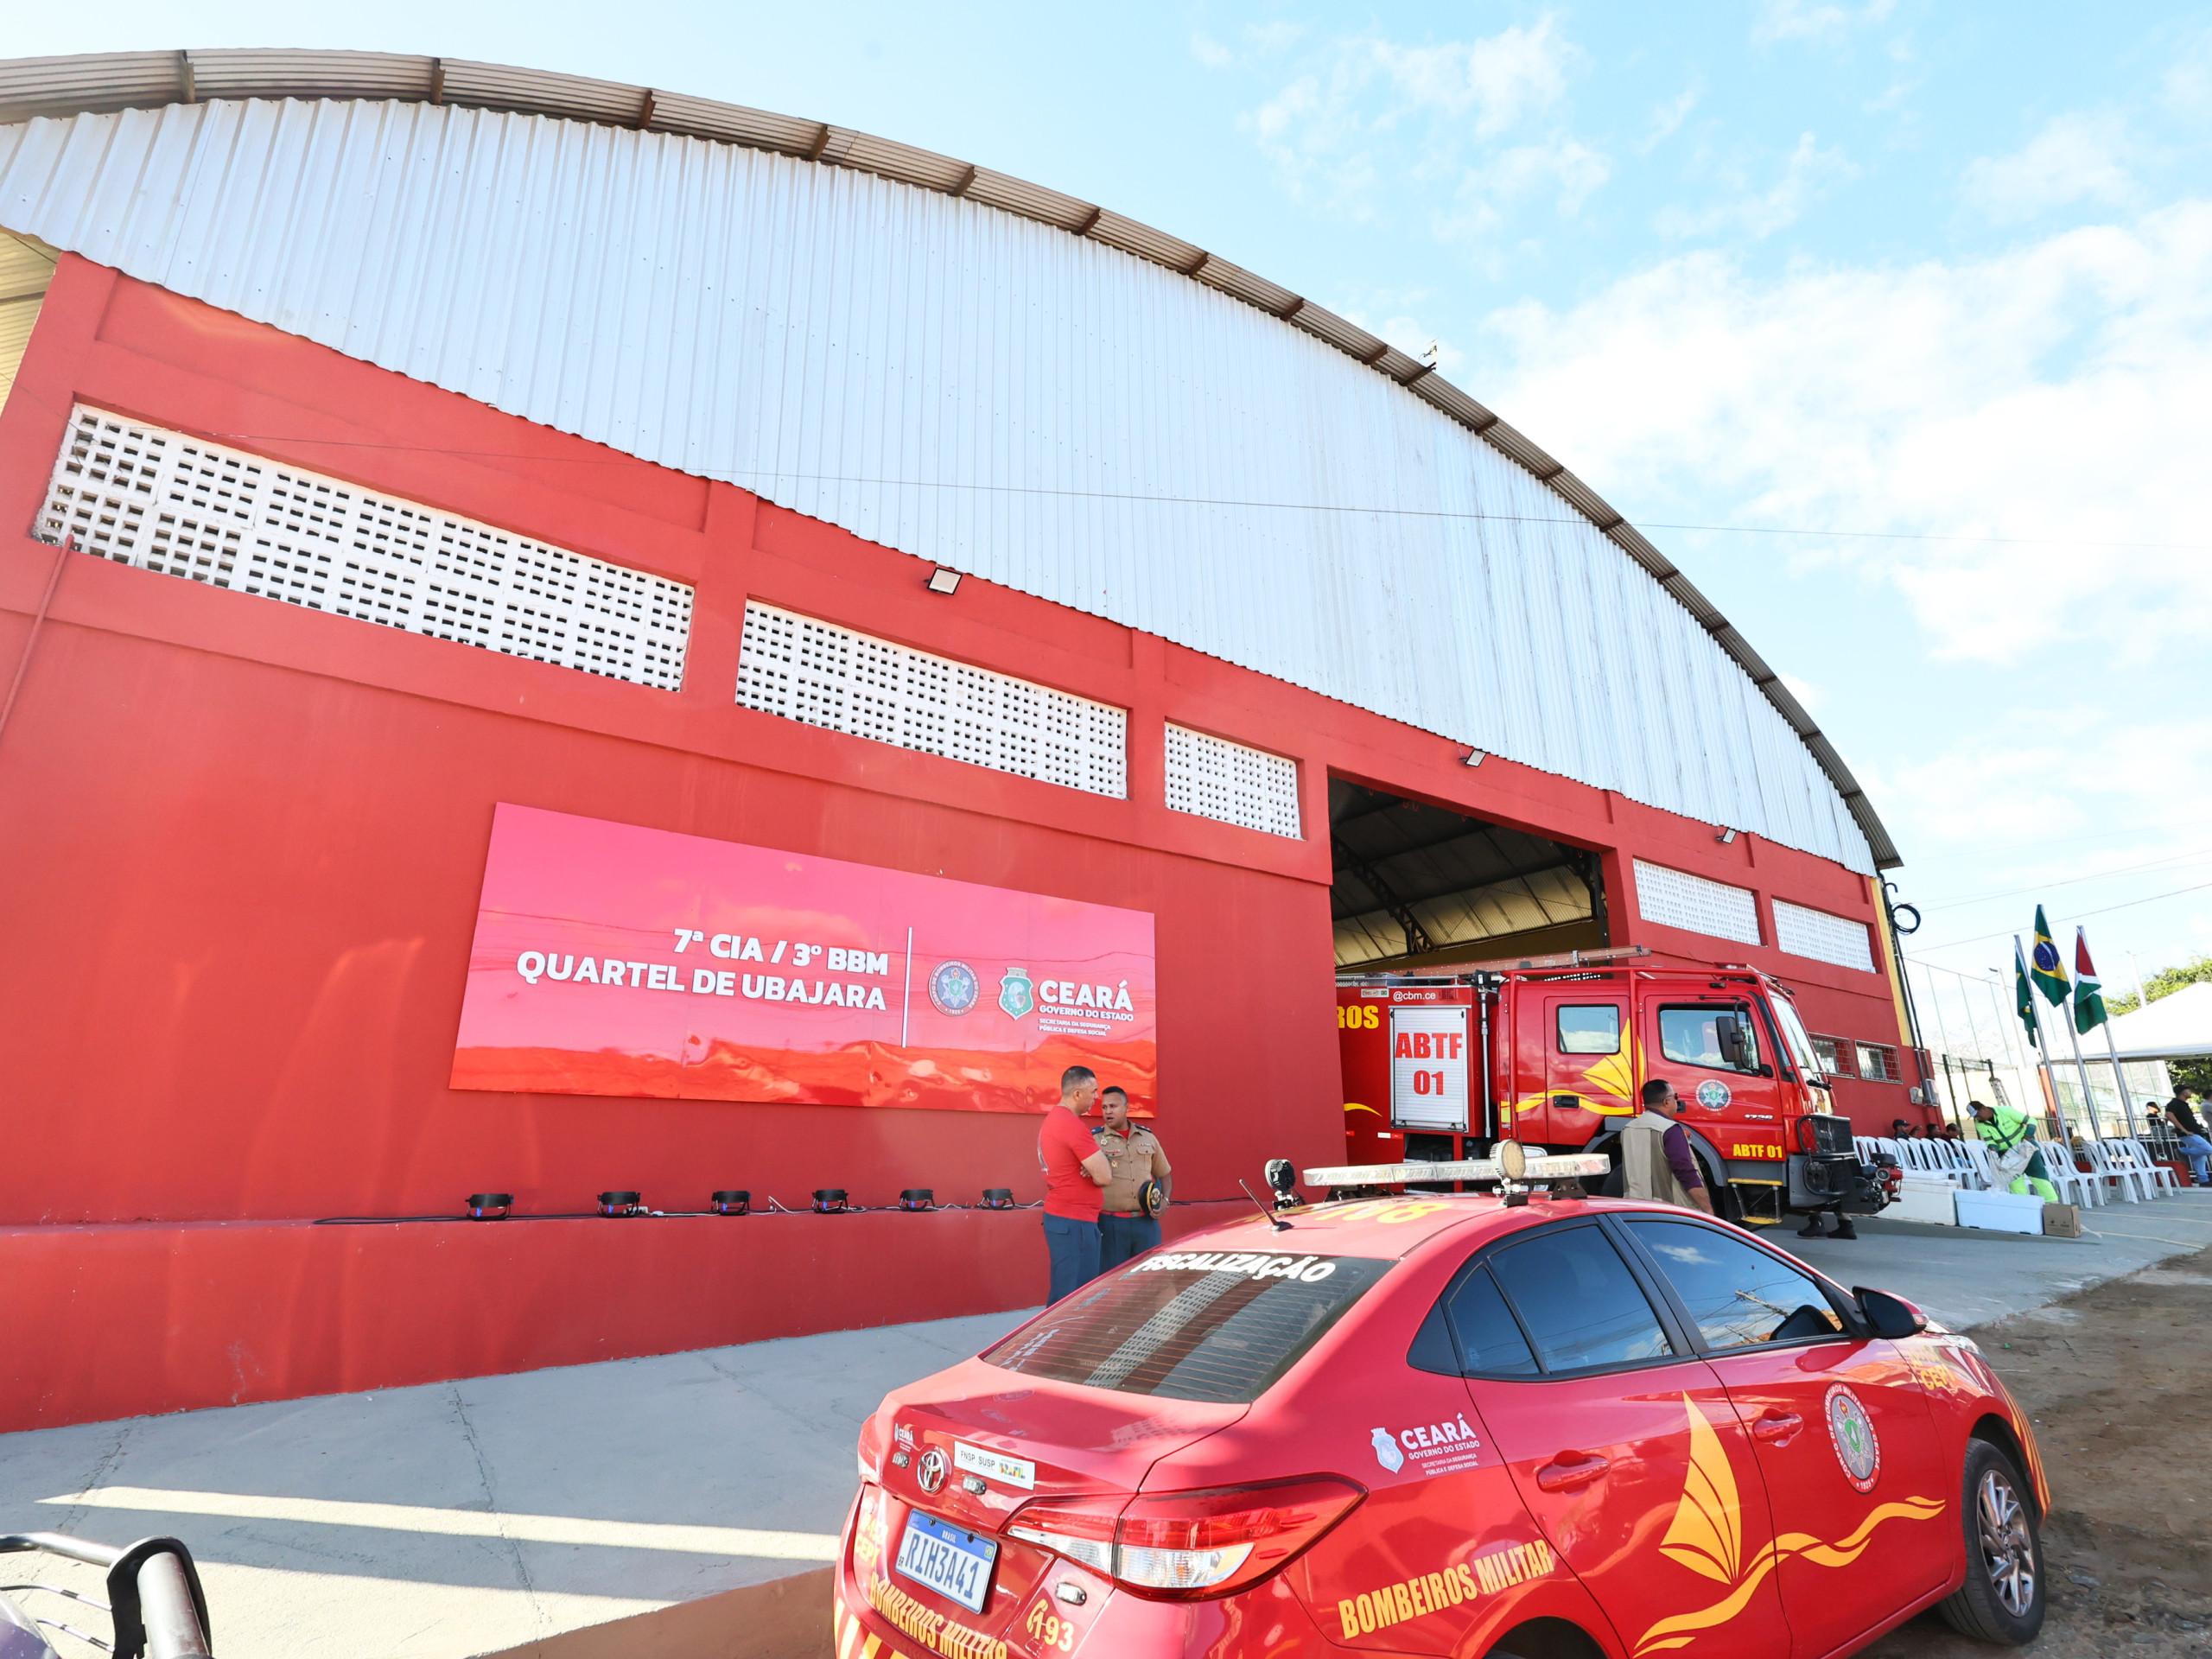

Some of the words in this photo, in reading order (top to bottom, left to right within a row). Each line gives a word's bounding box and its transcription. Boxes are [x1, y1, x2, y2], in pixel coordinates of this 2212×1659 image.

[673, 928, 704, 953] 7ª
[709, 933, 764, 963] CIA
[769, 940, 788, 964] /
[791, 943, 823, 967] 3º
[827, 947, 889, 976] BBM
[517, 950, 686, 992] QUARTEL
[692, 969, 736, 996] DE
[741, 974, 887, 1011] UBAJARA
[1039, 979, 1135, 1012] CEARÁ
[1393, 990, 1436, 1002] @cbm.ce
[1039, 1005, 1084, 1017] GOVERNO
[1085, 1009, 1099, 1019] DO
[1100, 1011, 1135, 1022] ESTADO
[1039, 1018, 1071, 1027] SECRETARIA
[1395, 1033, 1463, 1059] ABTF
[1413, 1070, 1444, 1096] 01
[1732, 1143, 1764, 1158] ABTF
[1766, 1145, 1783, 1159] 01
[1130, 1253, 1337, 1282] FISCALIZAÇÃO
[1824, 1384, 1842, 1422] BOMBEIROS
[1842, 1386, 1866, 1414] MILITAR
[1401, 1412, 1477, 1450] CEARÁ
[1827, 1422, 1836, 1440] DE
[1866, 1414, 1874, 1431] DO
[961, 1451, 976, 1462] FNSP
[978, 1456, 995, 1468] SUSP
[1408, 1446, 1443, 1460] GOVERNO
[1444, 1445, 1455, 1453] DO
[1455, 1440, 1480, 1452] ESTADO
[1833, 1442, 1852, 1478] CORPO
[1421, 1459, 1447, 1469] SECRETARIA
[1859, 1480, 1872, 1491] 1925
[941, 1529, 957, 1543] BRASIL
[905, 1533, 980, 1600] RIH3A41
[1338, 1562, 1478, 1640] BOMBEIROS
[1473, 1539, 1555, 1595] MILITAR
[869, 1571, 944, 1649] BOMBEIROS
[1033, 1611, 1074, 1652] 193
